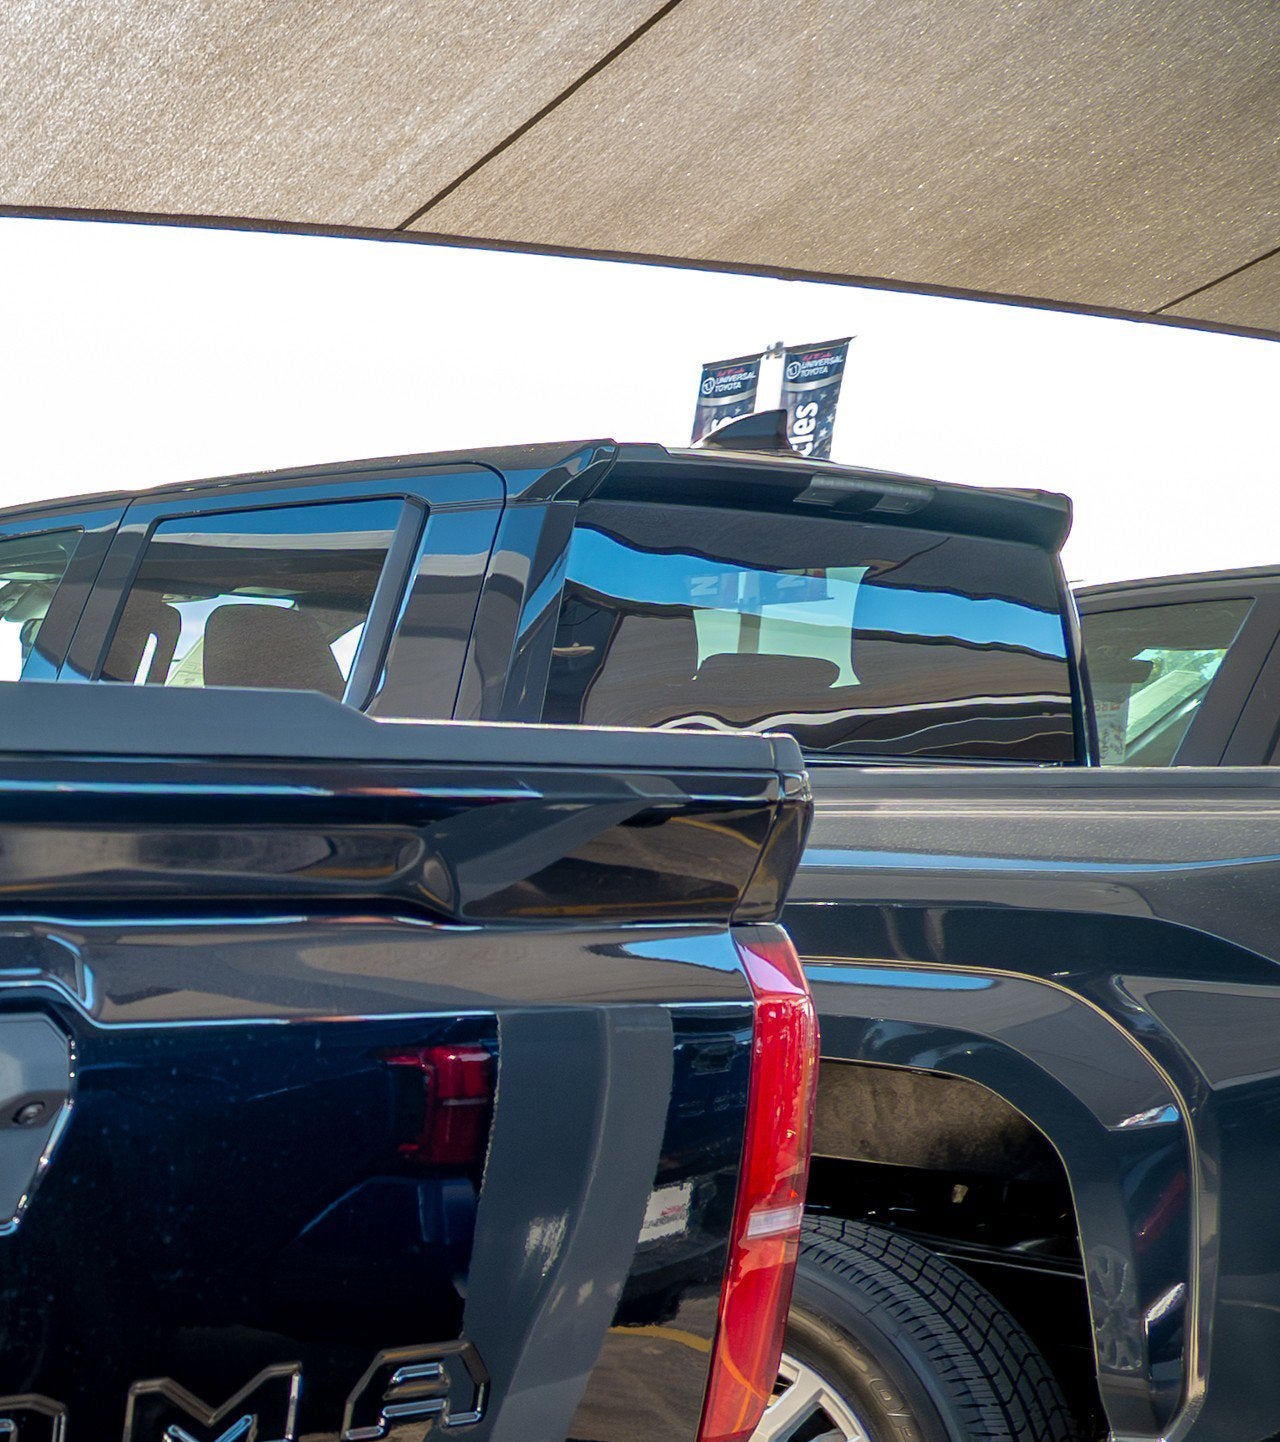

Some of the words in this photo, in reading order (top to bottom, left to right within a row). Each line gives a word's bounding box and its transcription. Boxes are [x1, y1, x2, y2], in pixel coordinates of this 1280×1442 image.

[801, 355, 843, 369] UNIVERSAL
[716, 371, 756, 384] UNIVERSAL
[800, 366, 828, 377] TOYOTA
[715, 381, 742, 392] TOYOTA
